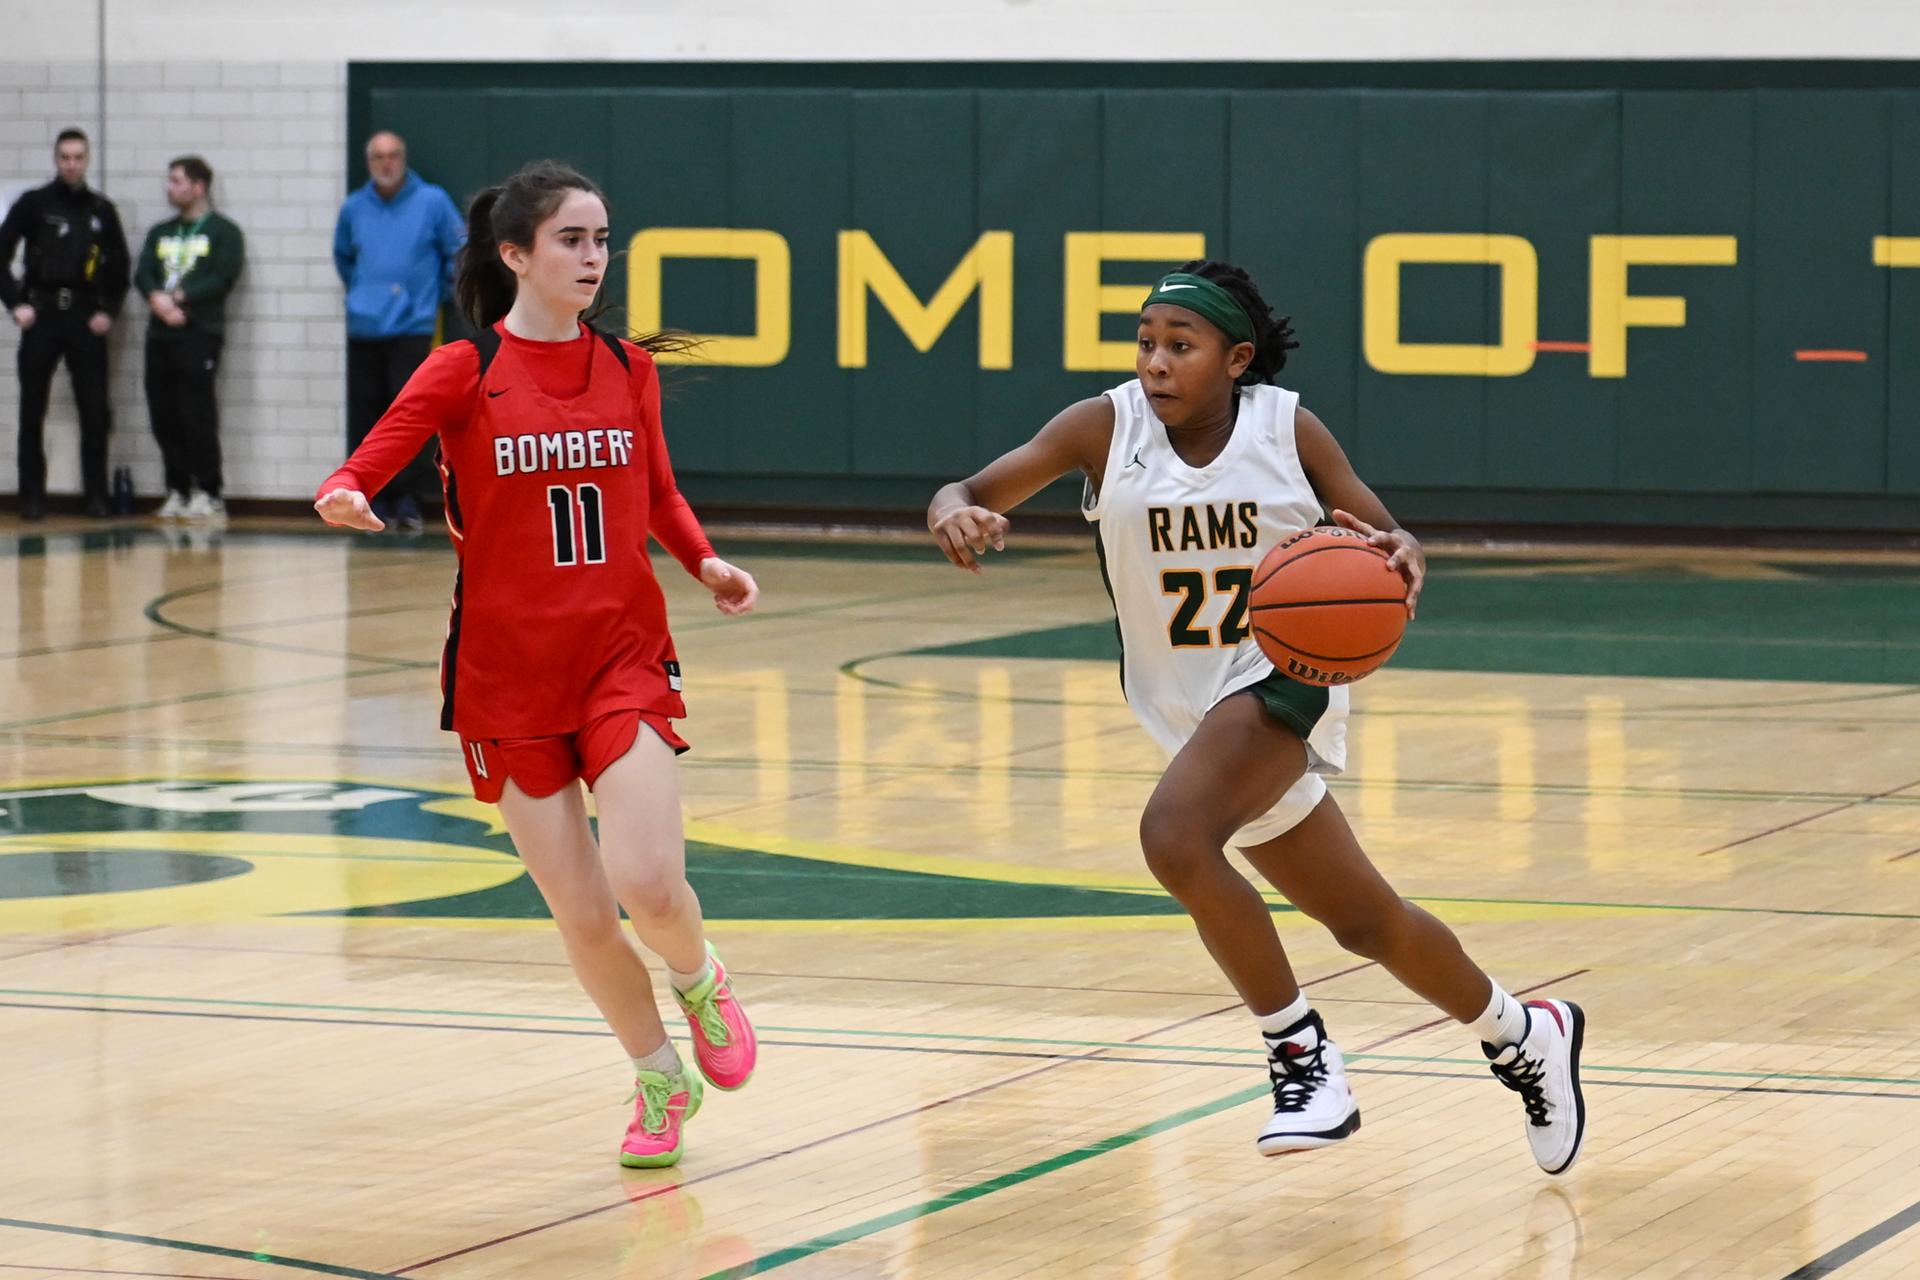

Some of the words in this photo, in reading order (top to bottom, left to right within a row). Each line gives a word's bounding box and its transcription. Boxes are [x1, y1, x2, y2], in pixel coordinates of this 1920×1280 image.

[627, 227, 1205, 373] OME
[1362, 232, 1738, 378] OF
[546, 482, 607, 567] 11
[1148, 502, 1258, 551] RAMS
[1159, 565, 1253, 649] 22
[1287, 657, 1377, 684] Wilso
